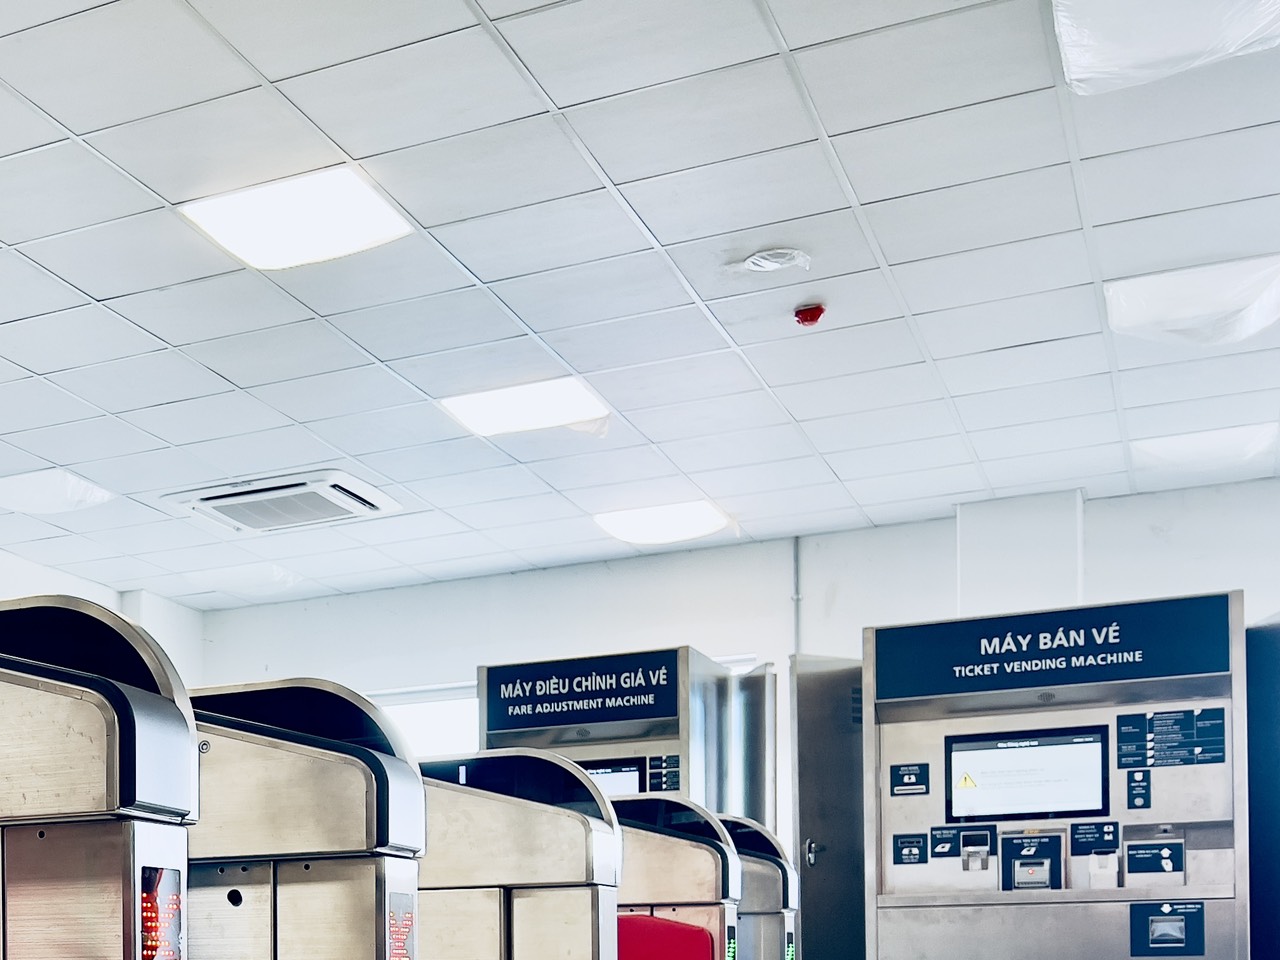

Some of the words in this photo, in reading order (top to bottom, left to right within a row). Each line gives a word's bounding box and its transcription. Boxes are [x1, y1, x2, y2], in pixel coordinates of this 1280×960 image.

[980, 632, 1032, 655] MÁY
[1039, 626, 1085, 649] BÁN
[1092, 621, 1120, 644] VÉ
[953, 663, 999, 678] TICKET
[1004, 657, 1066, 673] VENDING
[1071, 650, 1143, 667] MACHINE
[500, 679, 533, 699] MÁY
[620, 667, 646, 688] GIÁ
[649, 665, 668, 685] VÉ
[508, 704, 533, 716] FARE
[535, 698, 603, 714] ADJUSTMENT
[605, 694, 655, 708] MACHINE
